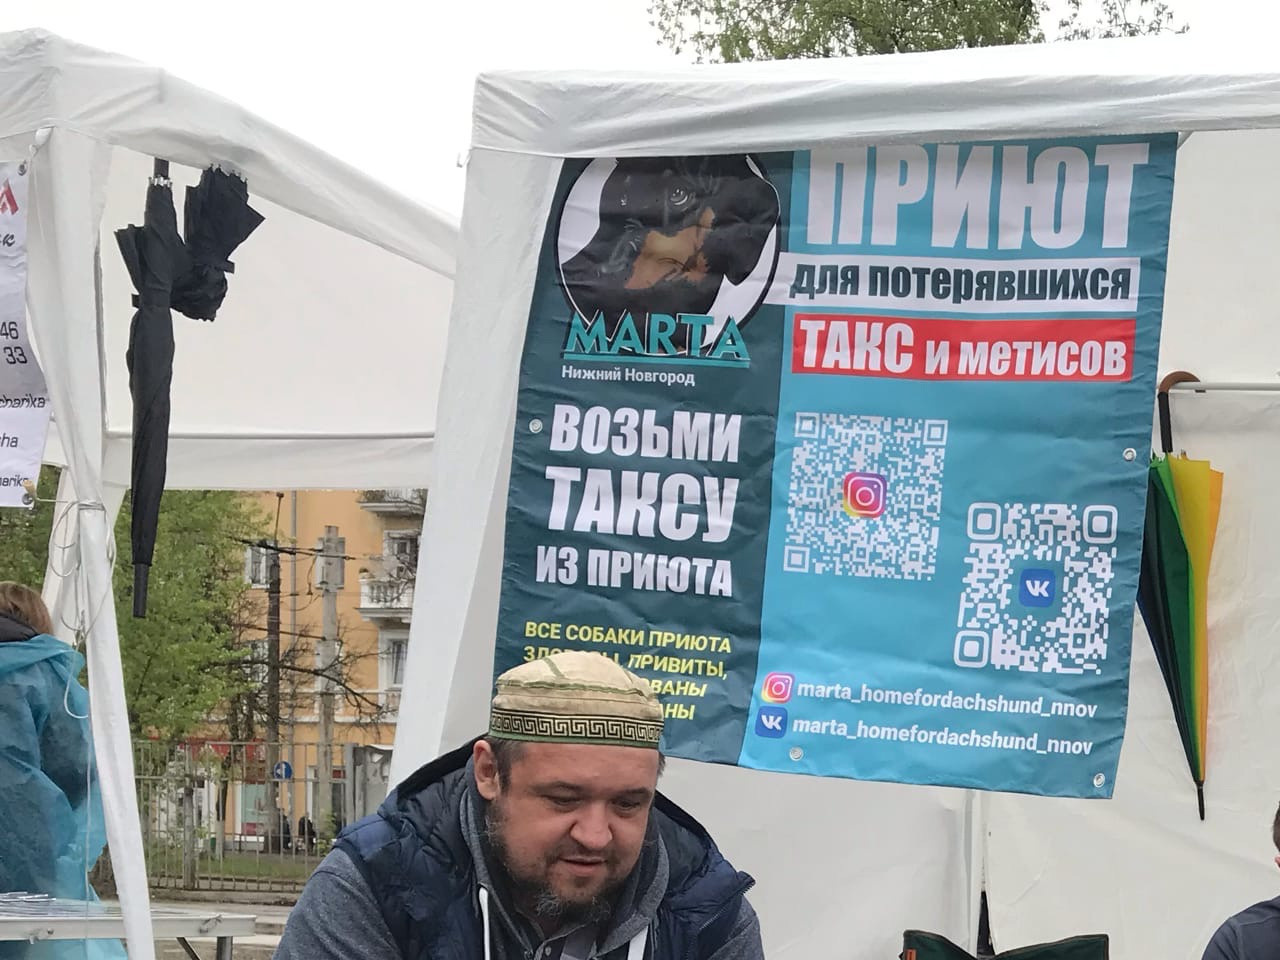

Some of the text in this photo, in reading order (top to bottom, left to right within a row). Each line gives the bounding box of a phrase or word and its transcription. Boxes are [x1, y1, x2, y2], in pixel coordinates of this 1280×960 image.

[807, 142, 1150, 250] ПРИЮТ
[789, 264, 1131, 303] для потерявшихся
[563, 309, 750, 361] MARTA
[800, 319, 1127, 376] ТАКС и метисов
[3, 346, 27, 364] 33
[561, 365, 695, 386] Нижний Новгород
[550, 404, 742, 462] ВОЗЬМИ
[545, 466, 740, 542] ТАКСУ
[536, 545, 733, 597] ИЗ ПРИЮТА
[525, 621, 731, 653] ВСЕ СОБАКИ ПРИЮТА
[628, 654, 728, 680] ПРИВИТЫ,
[797, 683, 1098, 718] marta_homefordachshund_nnov
[792, 719, 1093, 755] marta_homefordachshund_nnov
